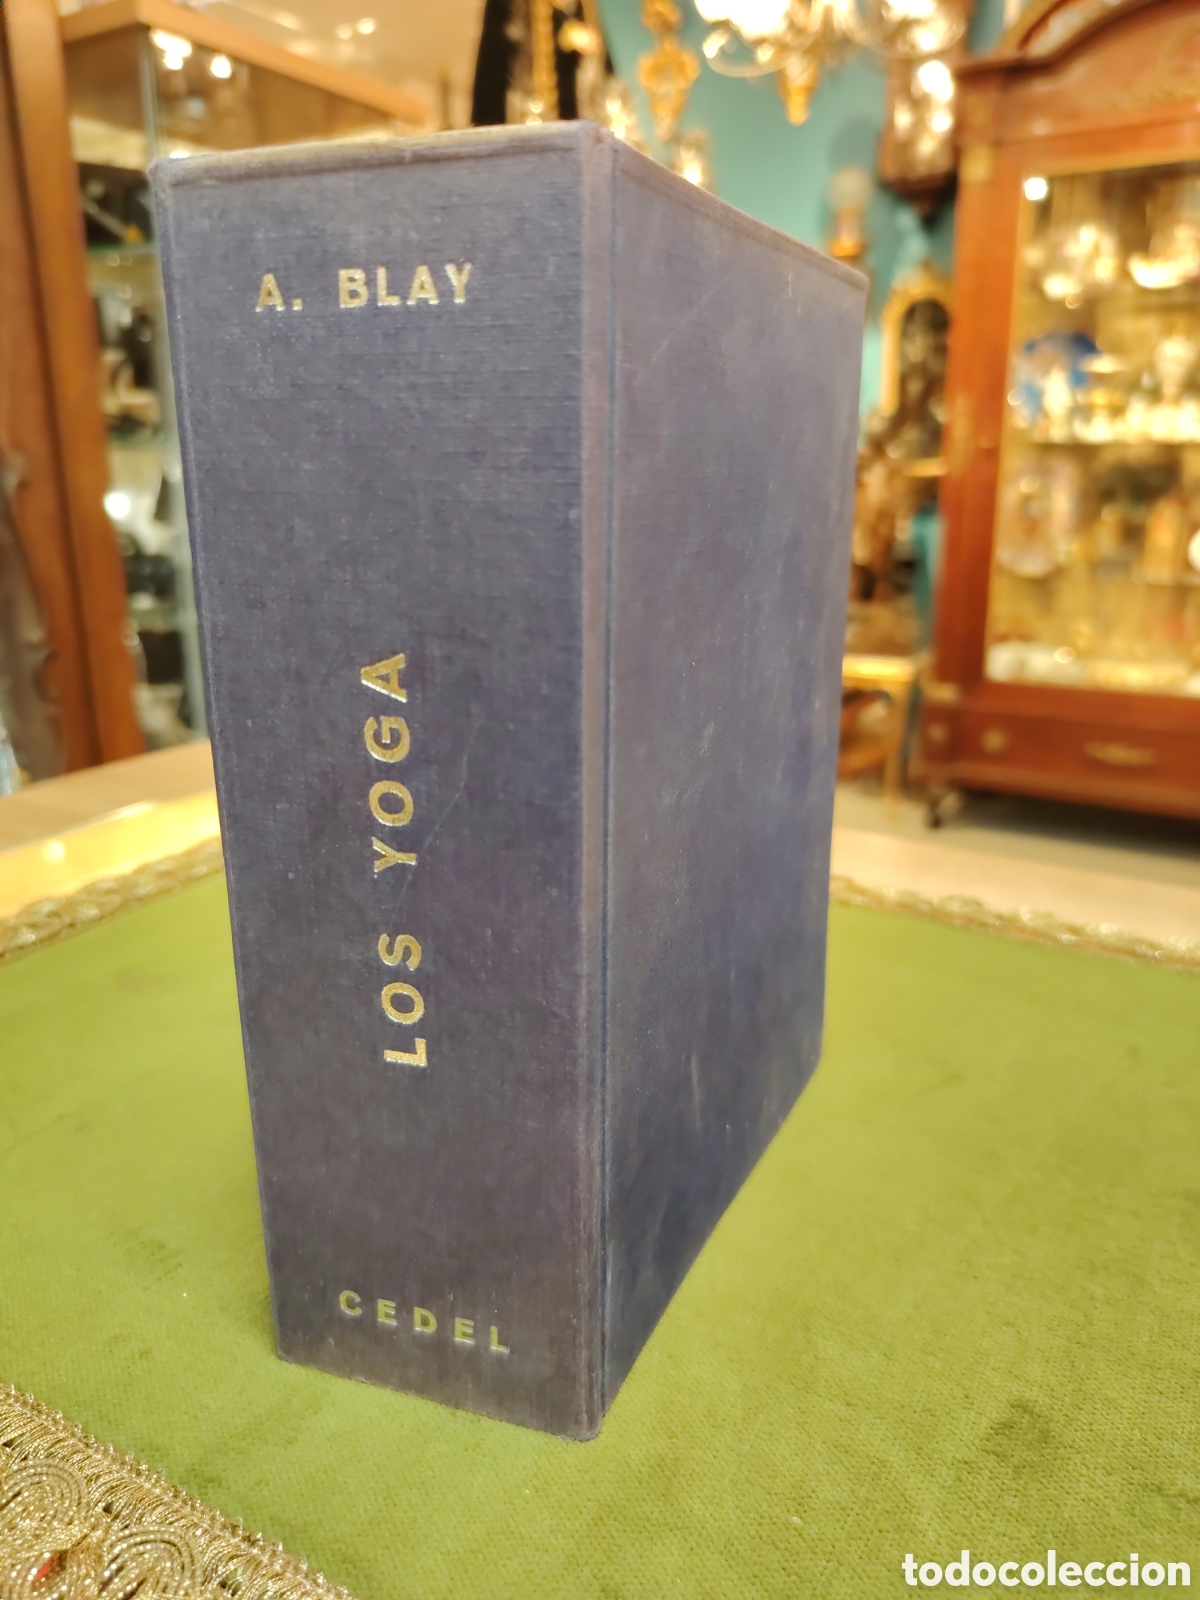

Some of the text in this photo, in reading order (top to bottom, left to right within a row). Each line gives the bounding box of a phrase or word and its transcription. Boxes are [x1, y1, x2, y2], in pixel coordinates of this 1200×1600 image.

[255, 263, 472, 312] A. BLAY
[360, 653, 428, 1067] LOS YOGA
[338, 1290, 509, 1353] CEDEL
